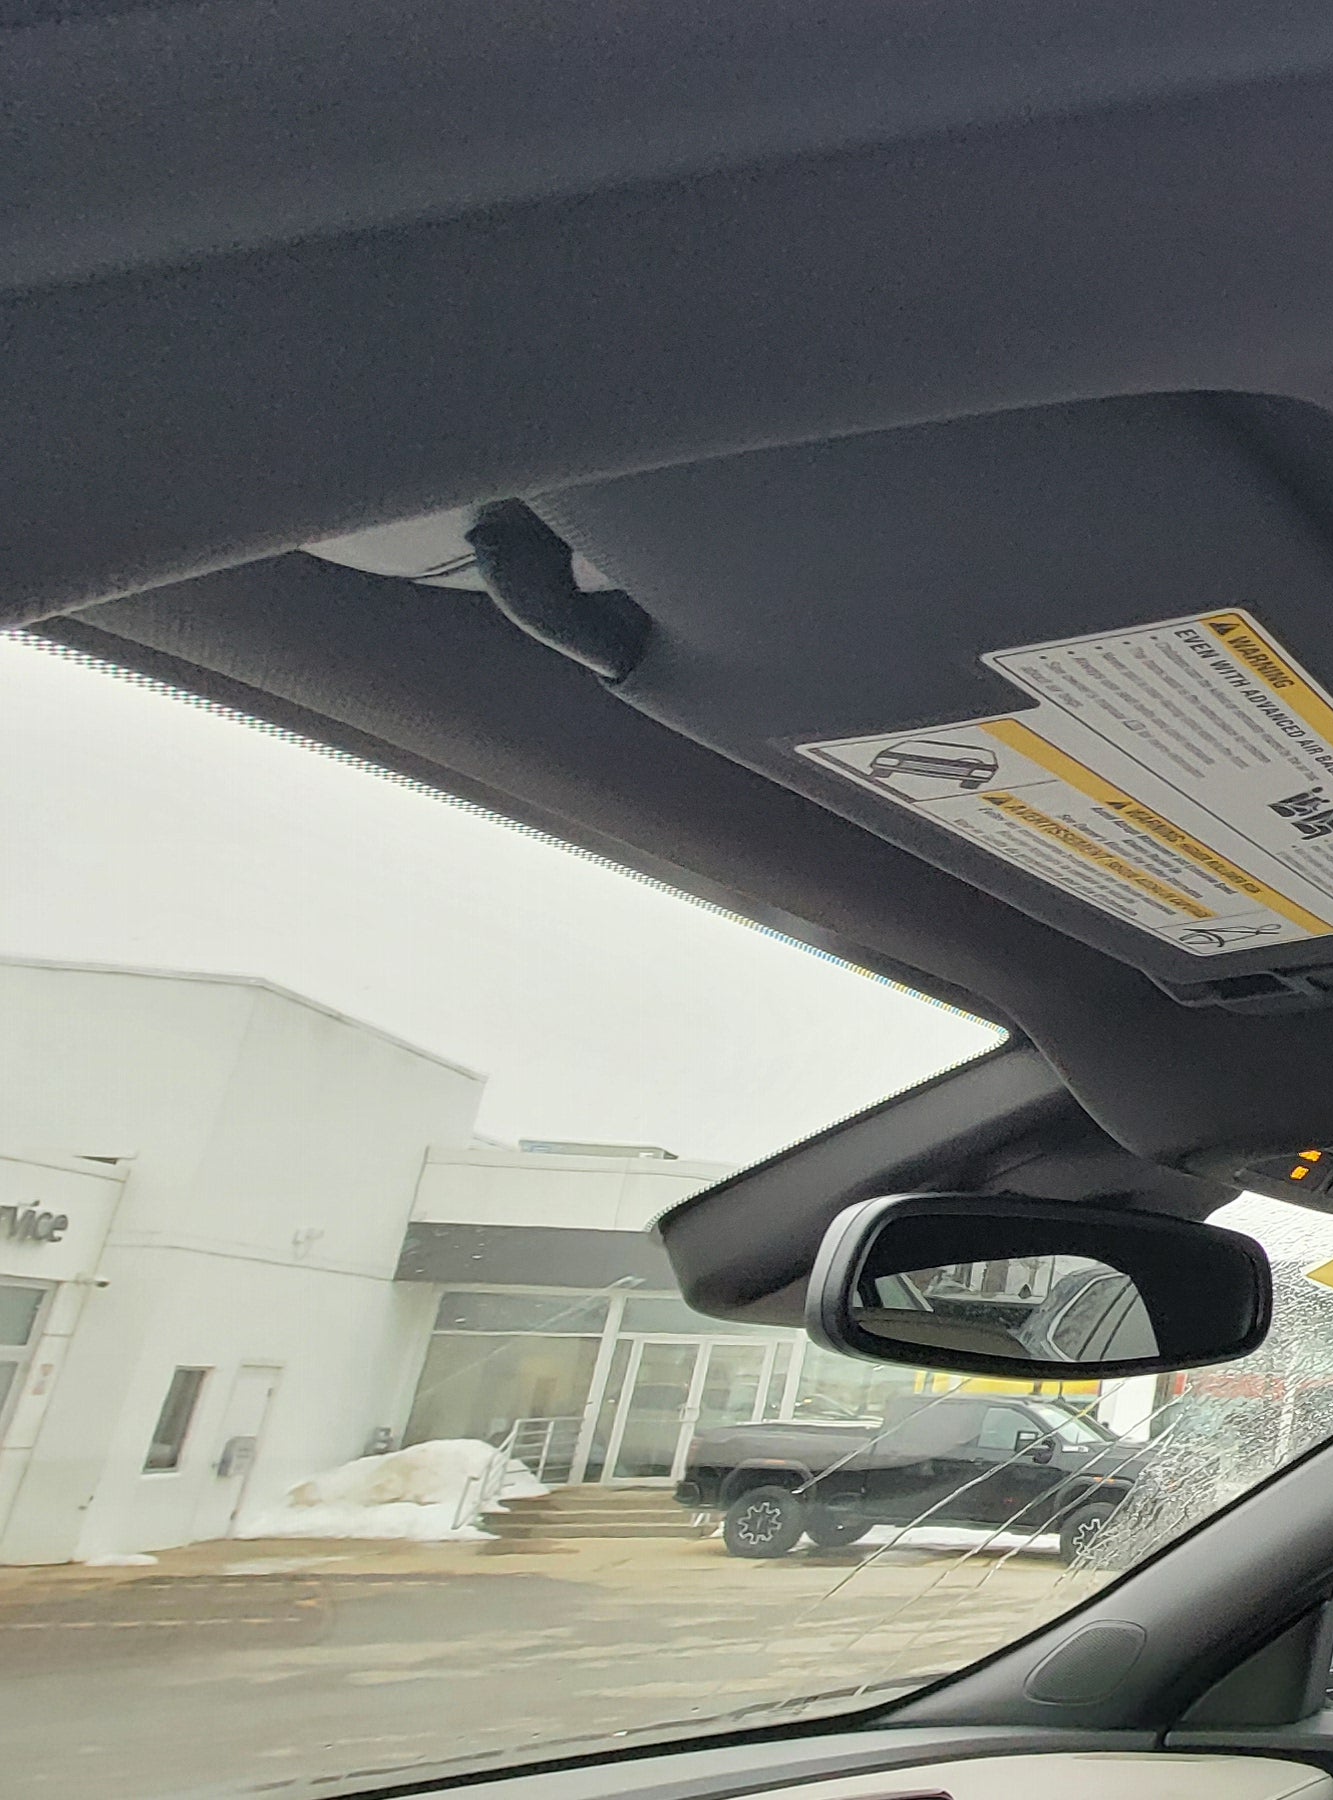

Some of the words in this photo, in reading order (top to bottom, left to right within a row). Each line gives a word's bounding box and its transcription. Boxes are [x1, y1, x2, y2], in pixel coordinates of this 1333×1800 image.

[1176, 628, 1219, 659] EVEN
[1210, 659, 1251, 687] WITH
[1242, 687, 1306, 737] ADVANCED
[1298, 737, 1324, 755] AIR
[1228, 634, 1295, 689] WARNING
